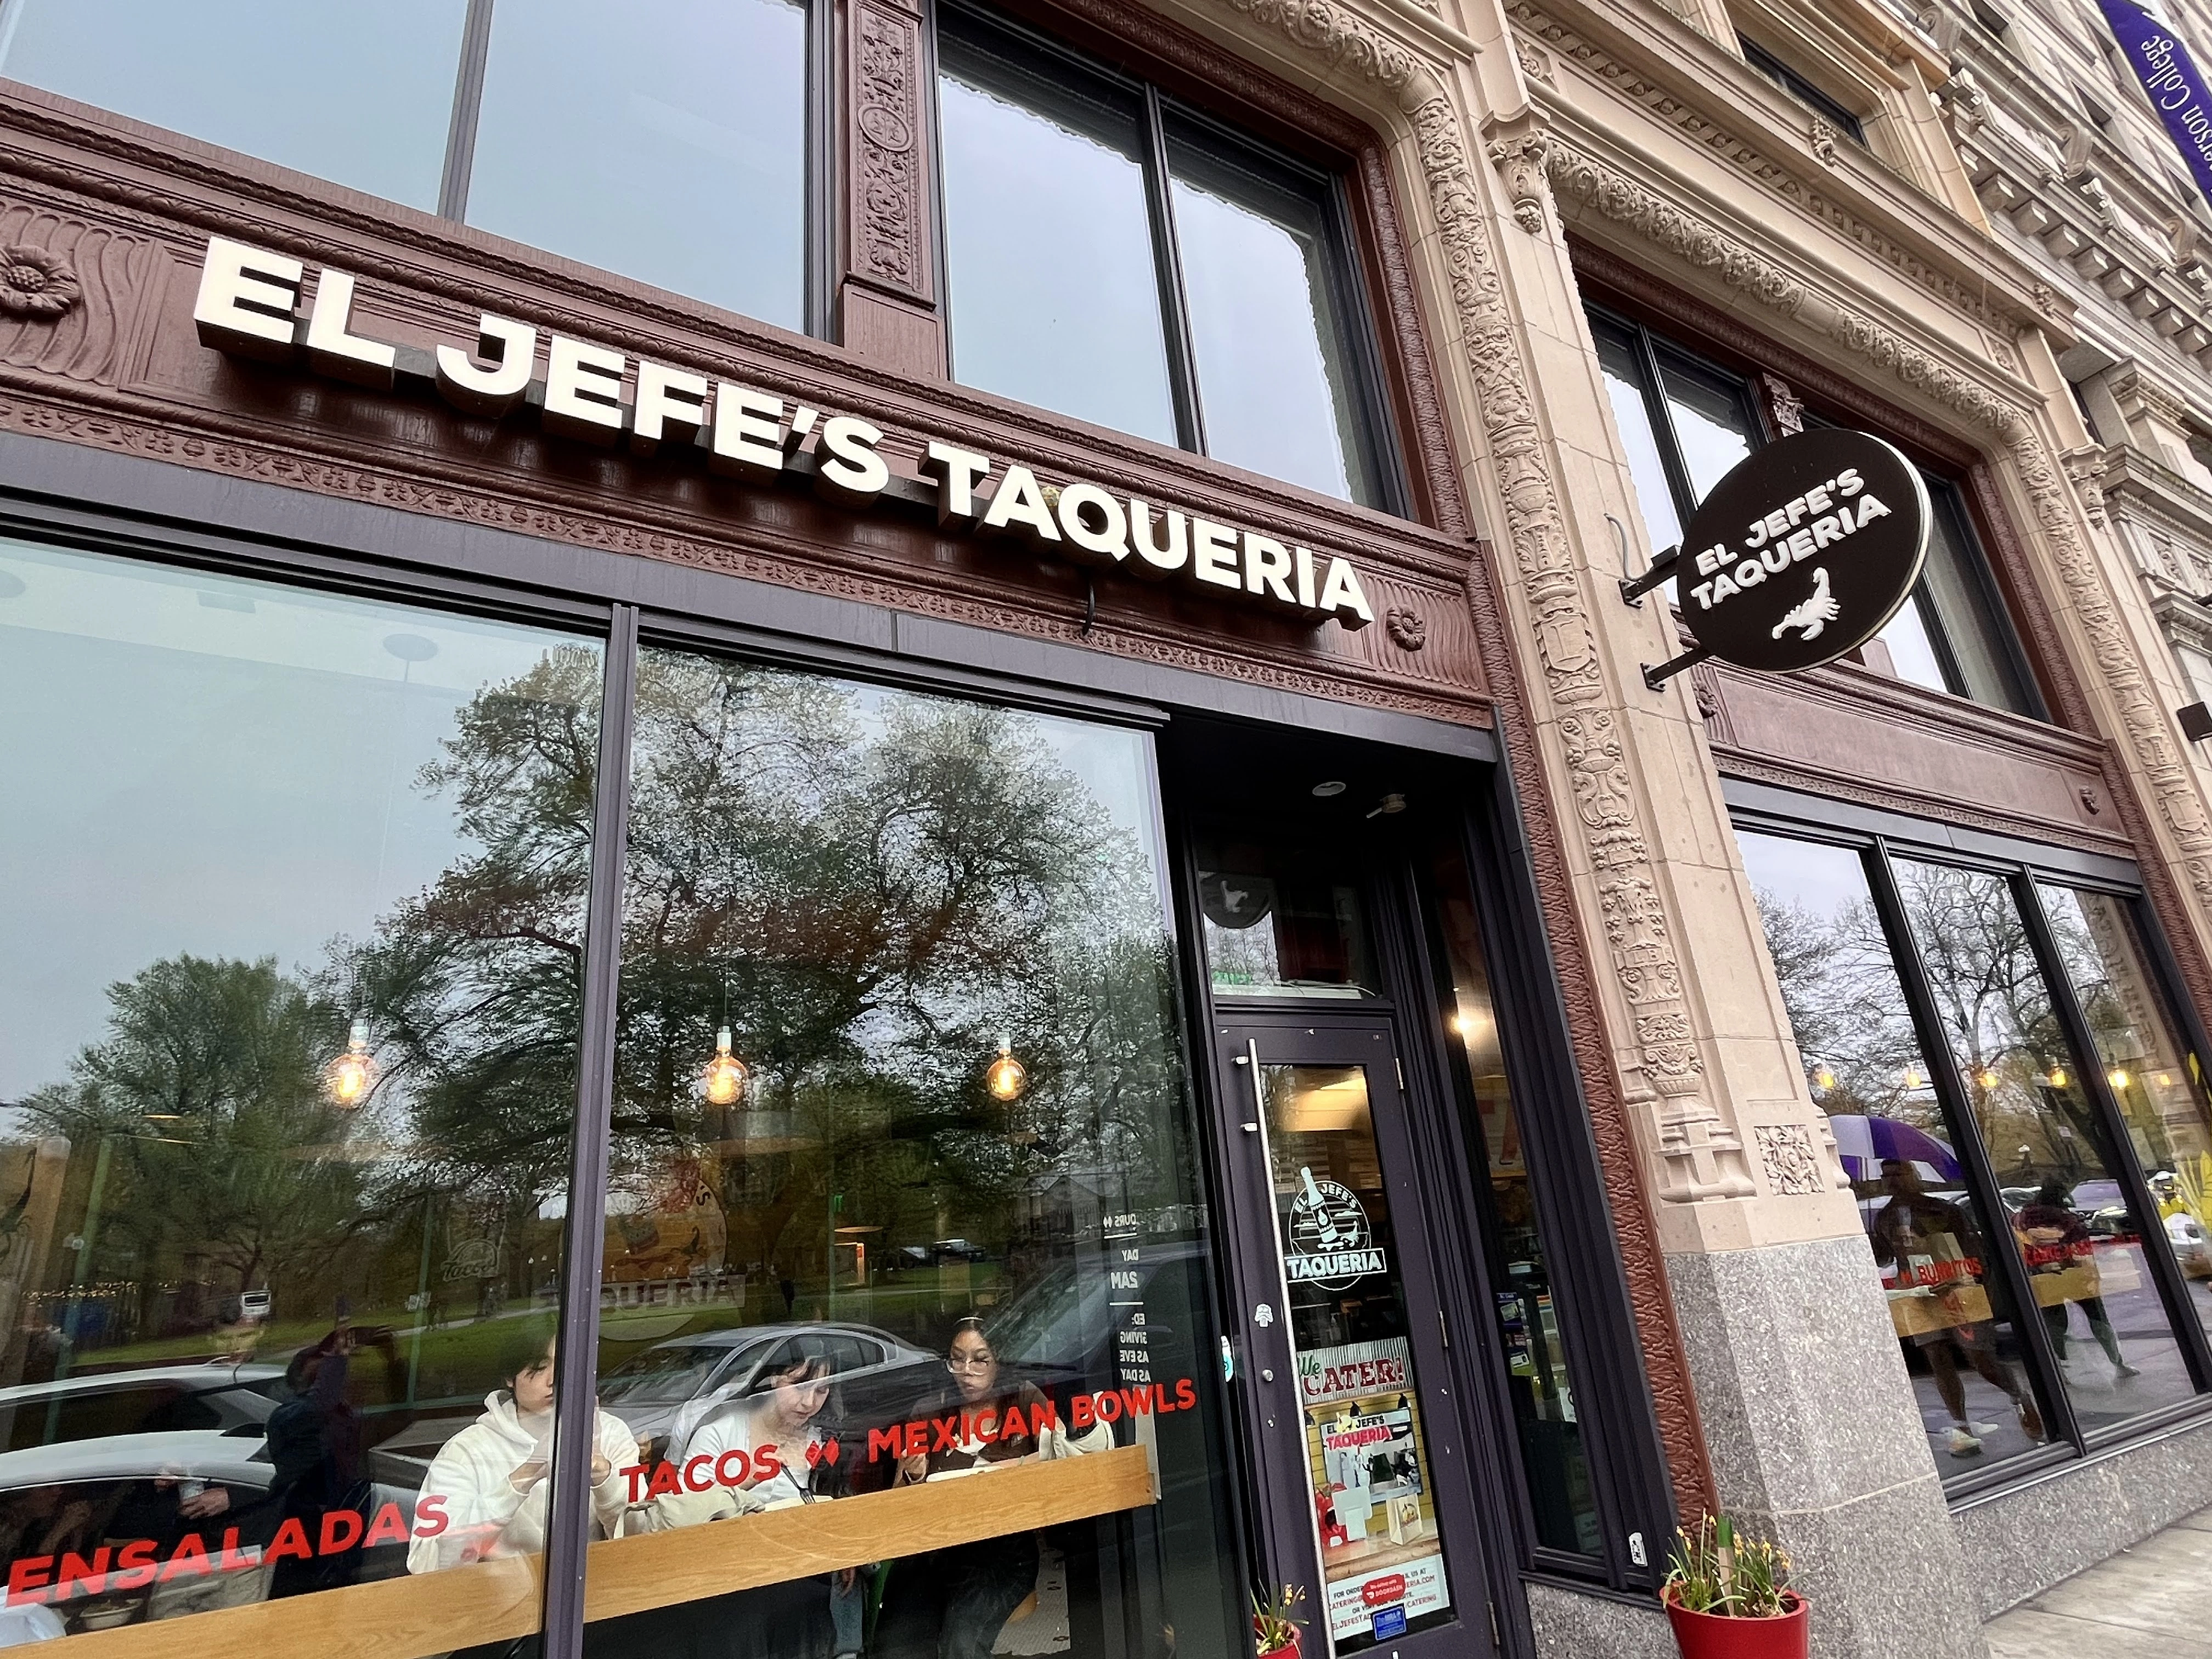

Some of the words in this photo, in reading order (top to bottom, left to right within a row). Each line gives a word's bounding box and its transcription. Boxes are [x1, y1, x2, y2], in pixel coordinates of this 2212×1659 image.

[2140, 35, 2191, 110] College
[193, 236, 396, 369] EL
[436, 313, 890, 493] JEFE'S
[928, 441, 1375, 624] TAQUERIA
[1690, 494, 1892, 610] TAQUERIA
[1695, 543, 1737, 576] EL
[1745, 468, 1865, 548] JEFE'S
[1294, 1197, 1308, 1214] EL
[1321, 1183, 1357, 1209] JEFE'S
[1286, 1252, 1382, 1279] TAQUERIA
[1304, 1357, 1404, 1396] CATER!
[868, 1401, 1056, 1463] MEXICAN
[1071, 1379, 1197, 1424] BOWLS
[1326, 1425, 1393, 1451] TAQUERIA
[1327, 1424, 1336, 1434] EL
[1356, 1415, 1385, 1429] JEFE'S
[620, 1444, 782, 1503] TACOS
[6, 1495, 449, 1607] ENSALADAS
